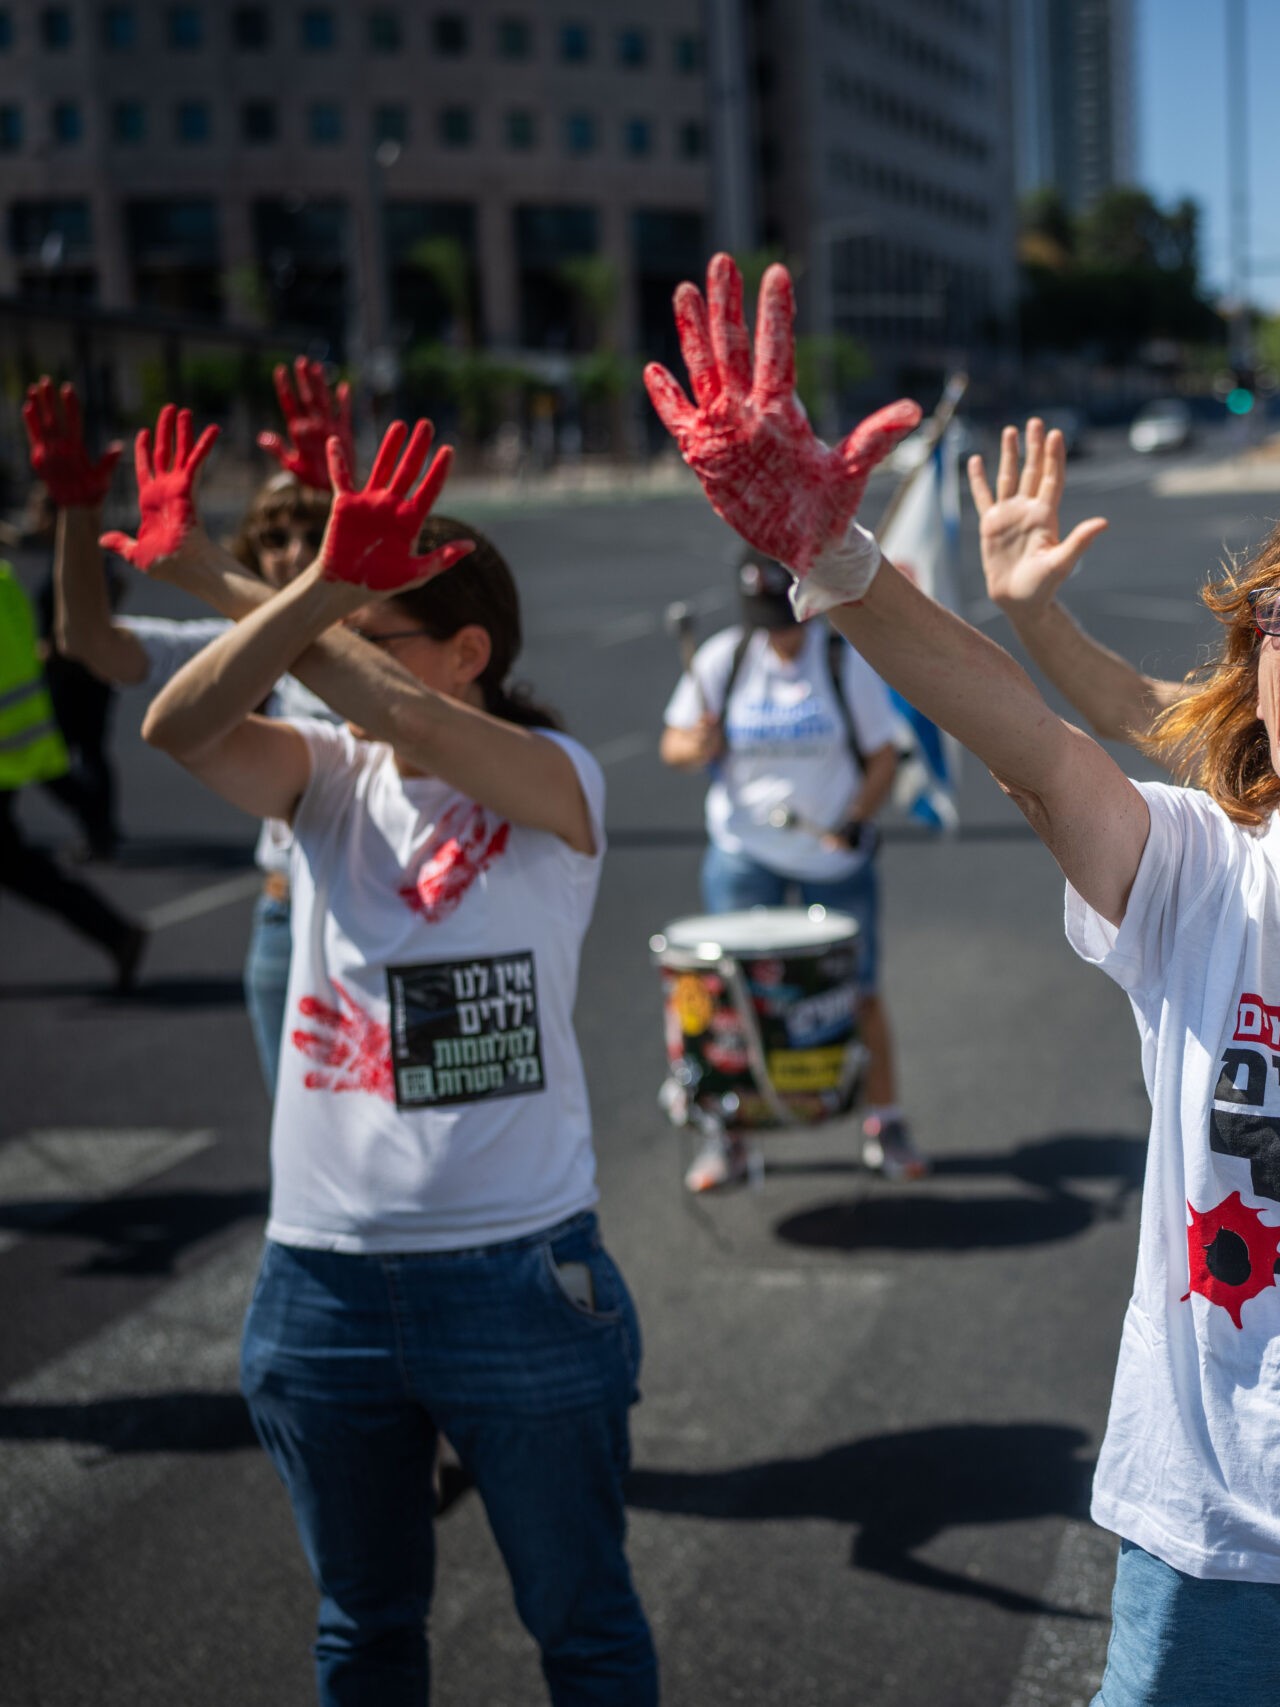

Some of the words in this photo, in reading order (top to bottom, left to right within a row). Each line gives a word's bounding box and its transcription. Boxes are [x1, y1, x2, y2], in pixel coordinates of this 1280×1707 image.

[453, 963, 490, 999] לנו
[495, 959, 532, 996] אין
[456, 991, 534, 1035] ילדים
[433, 1026, 536, 1068] למלחמות
